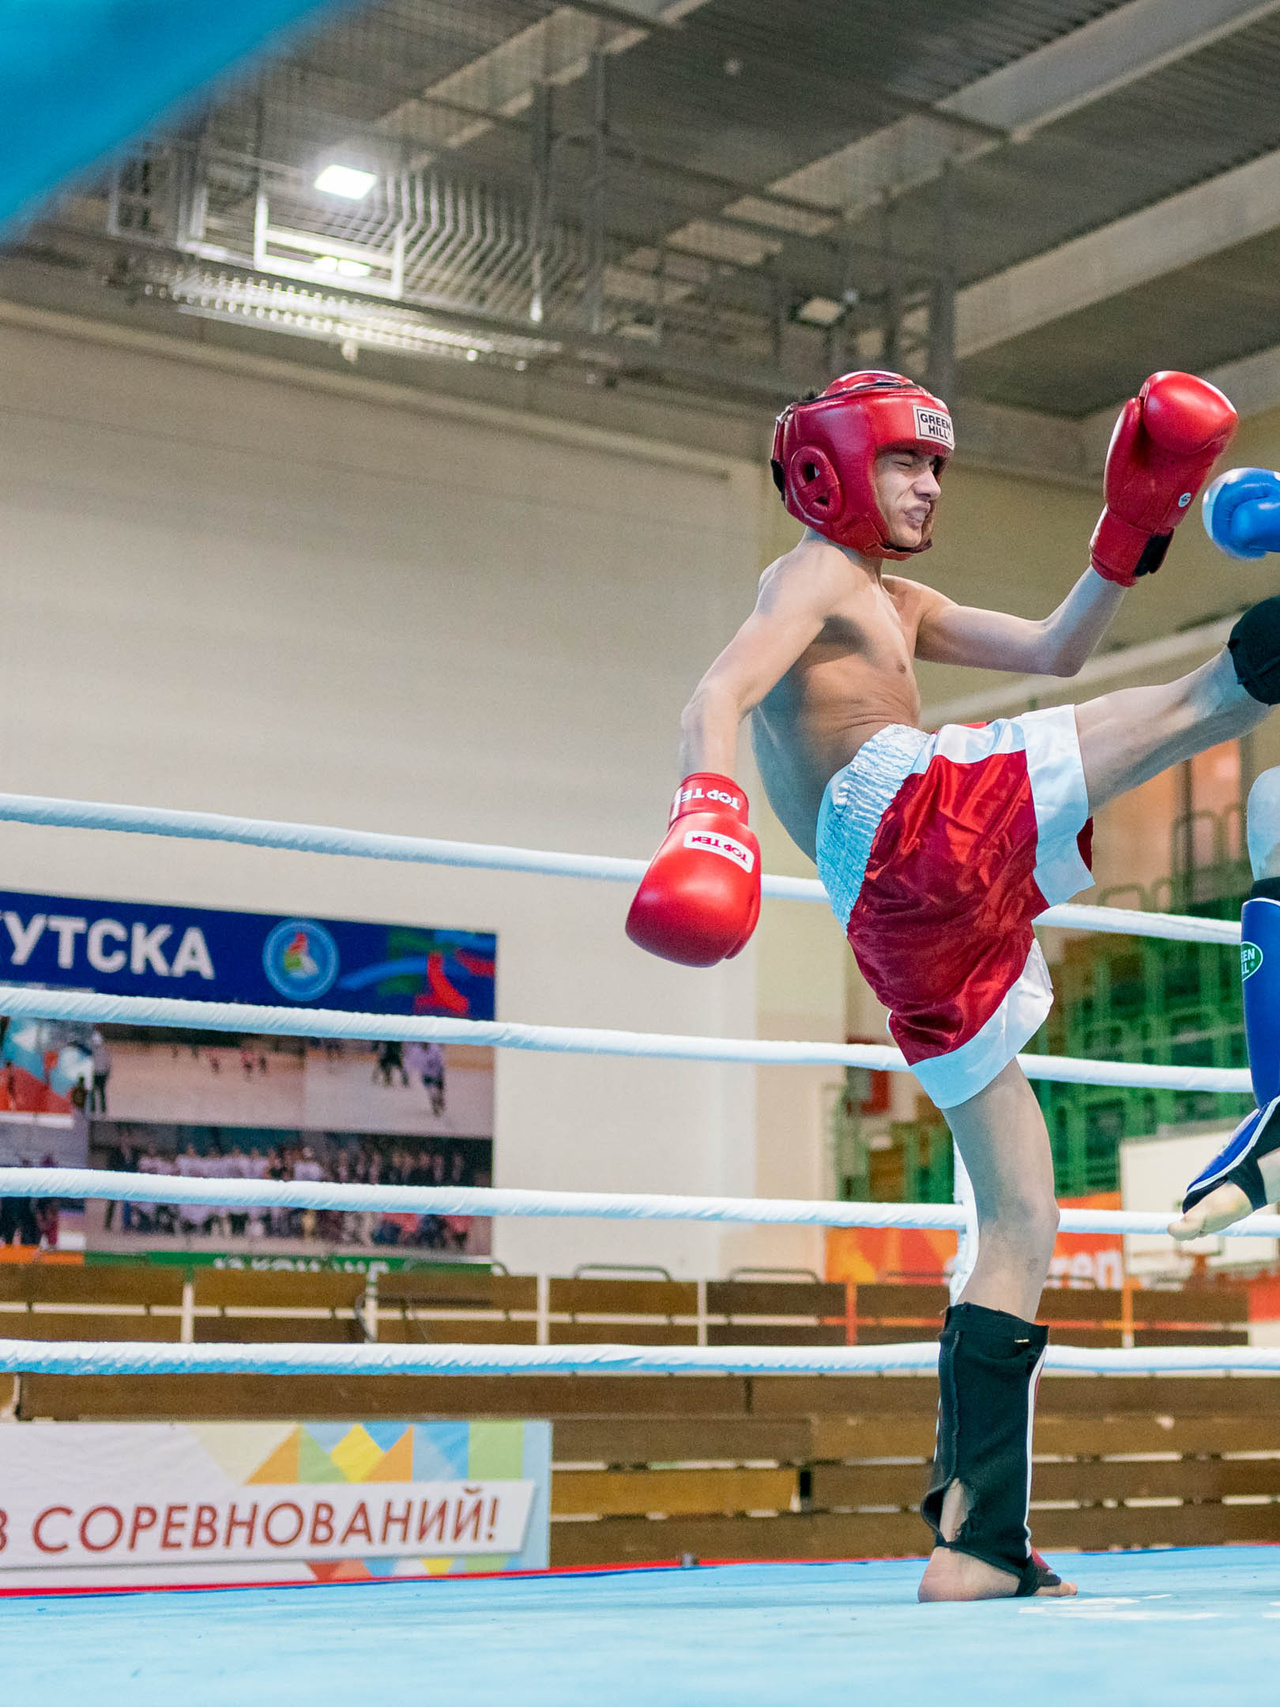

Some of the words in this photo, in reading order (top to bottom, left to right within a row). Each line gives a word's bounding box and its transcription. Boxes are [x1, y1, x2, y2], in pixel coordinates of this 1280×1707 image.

[920, 413, 951, 431] GREEN
[928, 425, 948, 440] HILL
[681, 788, 705, 803] TE
[706, 789, 740, 811] TOP
[723, 843, 748, 864] TOP
[0, 911, 215, 979] УТСКА
[32, 1487, 499, 1553] СОРЕВНОВАНИЙ!
